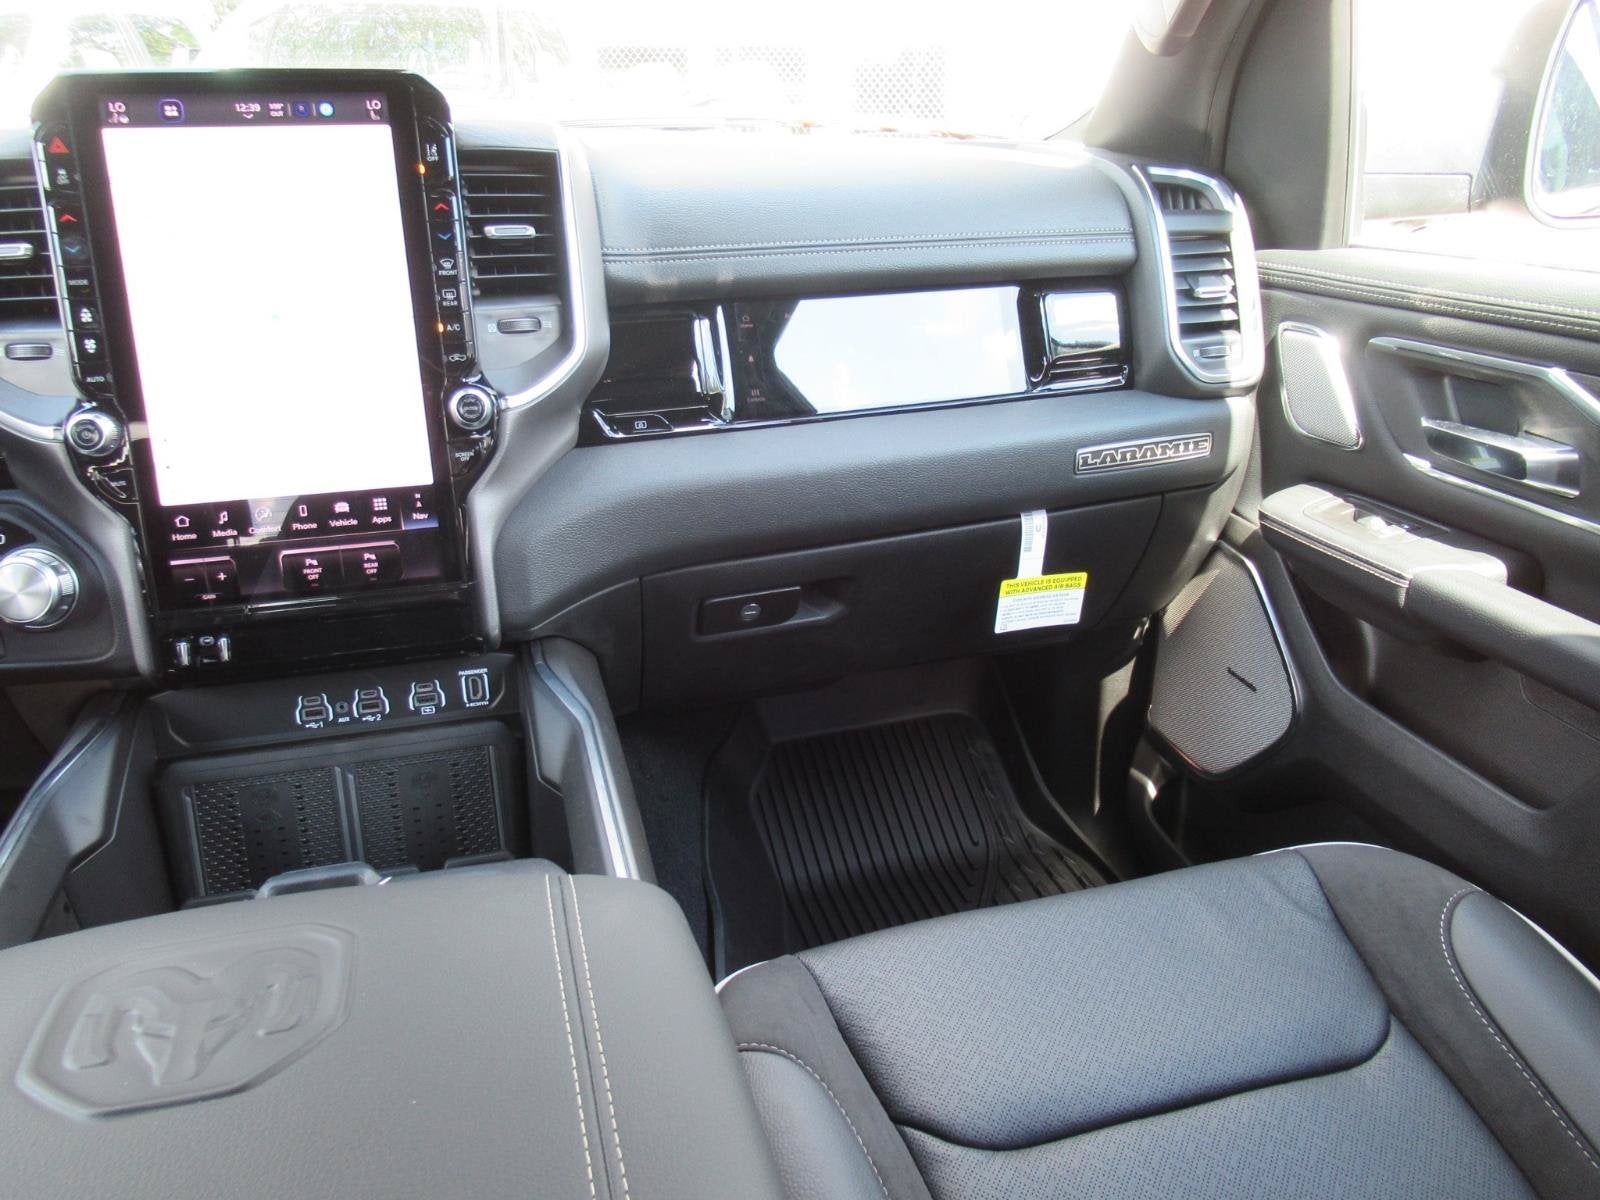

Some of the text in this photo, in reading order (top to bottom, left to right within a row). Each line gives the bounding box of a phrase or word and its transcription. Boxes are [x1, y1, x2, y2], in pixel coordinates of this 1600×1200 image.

[108, 102, 126, 113] LO
[234, 103, 261, 112] 12:39
[366, 100, 381, 111] LO
[86, 375, 105, 383] AUTO
[1079, 438, 1209, 469] LARAMIE
[171, 532, 198, 541] Home
[212, 528, 238, 538] Media
[292, 522, 318, 531] Phone
[329, 518, 358, 527] Vehicle
[372, 514, 392, 525] Apps
[412, 512, 429, 520] Nav
[1053, 576, 1082, 584] EQUIPPED
[1021, 584, 1053, 593] ADVANCED
